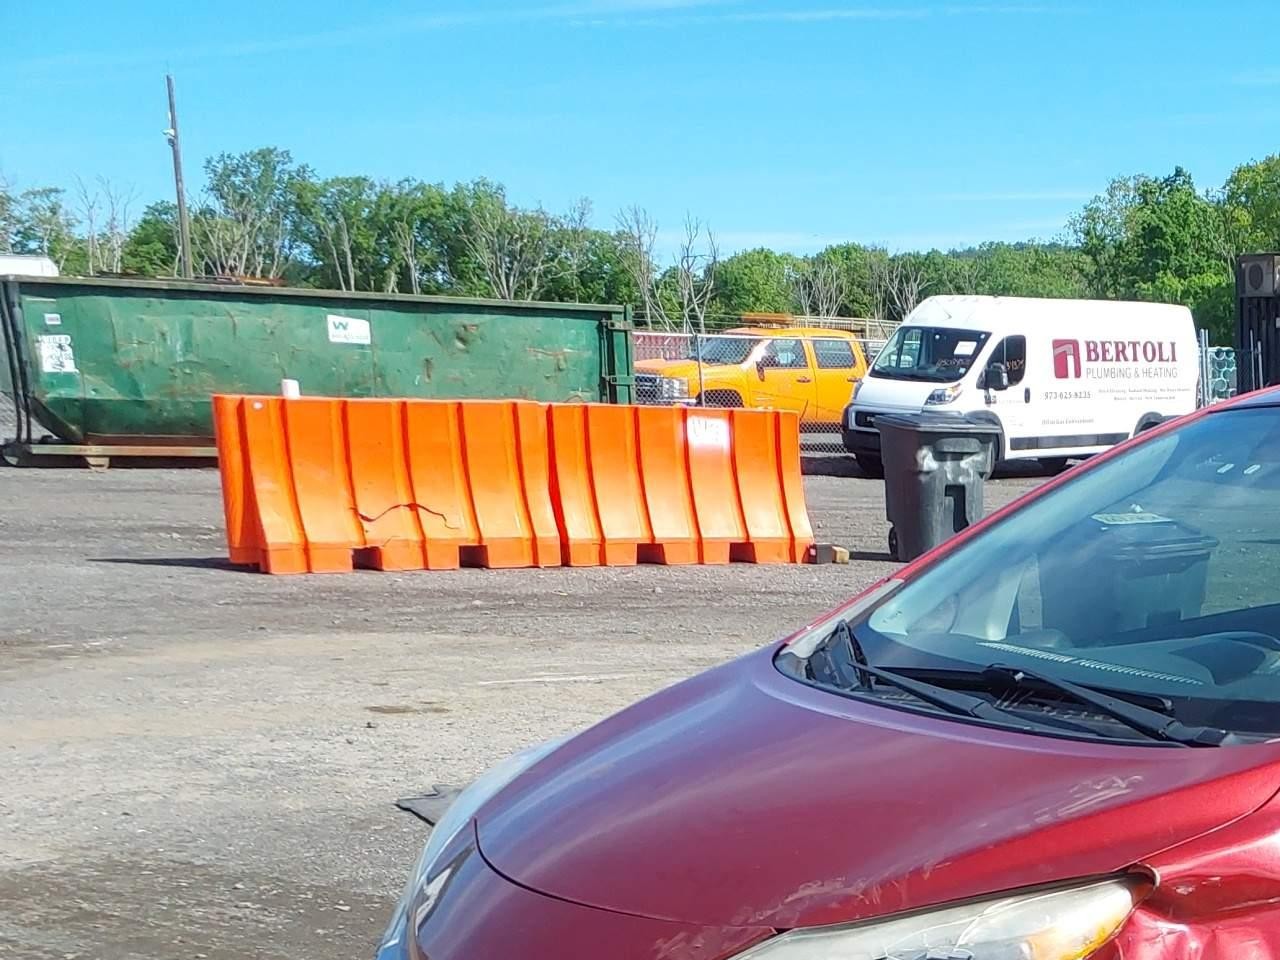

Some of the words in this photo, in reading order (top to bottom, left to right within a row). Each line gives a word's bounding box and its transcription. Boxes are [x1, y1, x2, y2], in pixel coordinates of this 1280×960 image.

[1085, 340, 1178, 363] BERTOLI
[1086, 367, 1131, 379] PLUMBING
[1133, 367, 1140, 379] &
[1142, 367, 1178, 379] HEATING
